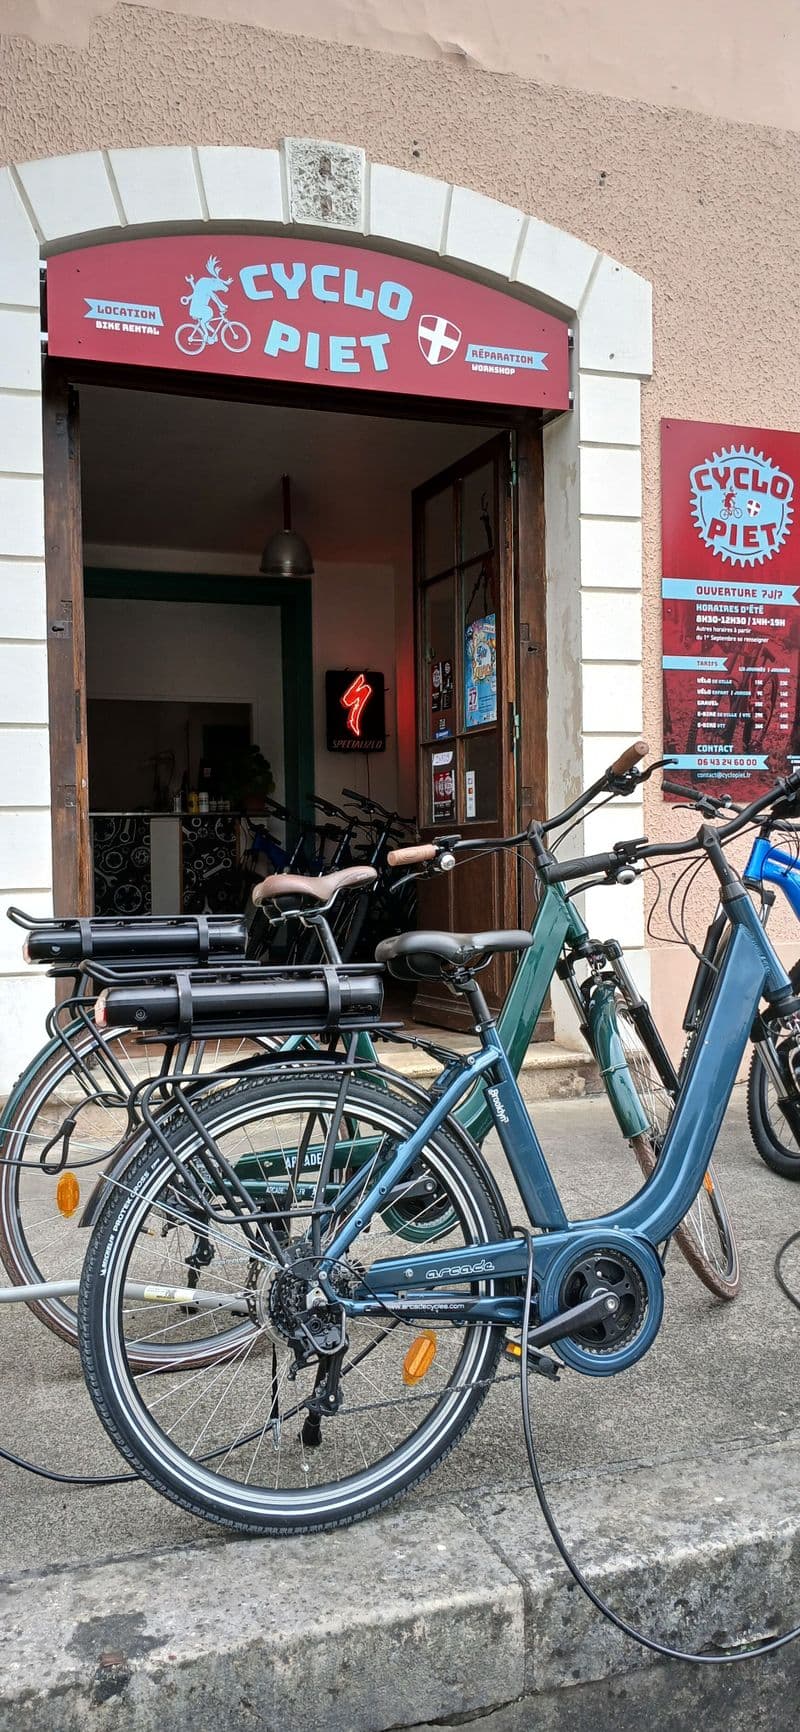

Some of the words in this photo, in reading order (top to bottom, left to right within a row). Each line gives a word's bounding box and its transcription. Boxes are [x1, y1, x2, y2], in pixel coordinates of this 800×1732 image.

[239, 263, 413, 321] CYCLO
[97, 305, 156, 320] LOCATION
[95, 320, 121, 331] BIKE
[122, 323, 160, 336] RENTAL
[264, 320, 391, 373] PIET
[471, 348, 534, 364] RÉPARATION
[471, 363, 516, 375] WORKSHOP
[694, 466, 790, 500] CYCLO
[707, 517, 777, 548] PIET
[696, 585, 758, 598] OUVERTURE
[761, 589, 783, 601] 7J/7
[696, 604, 739, 613] HORAIRES
[740, 604, 765, 615] D'ÉTÉ
[697, 758, 708, 766] 06
[710, 758, 720, 766] 43
[722, 758, 732, 766] 24
[734, 758, 744, 766] 60
[746, 758, 757, 766] 00
[488, 1088, 509, 1123] Brooklyn
[285, 1153, 322, 1168] ARADE
[113, 1199, 132, 1231] PROTEK
[425, 1260, 495, 1279] arcade
